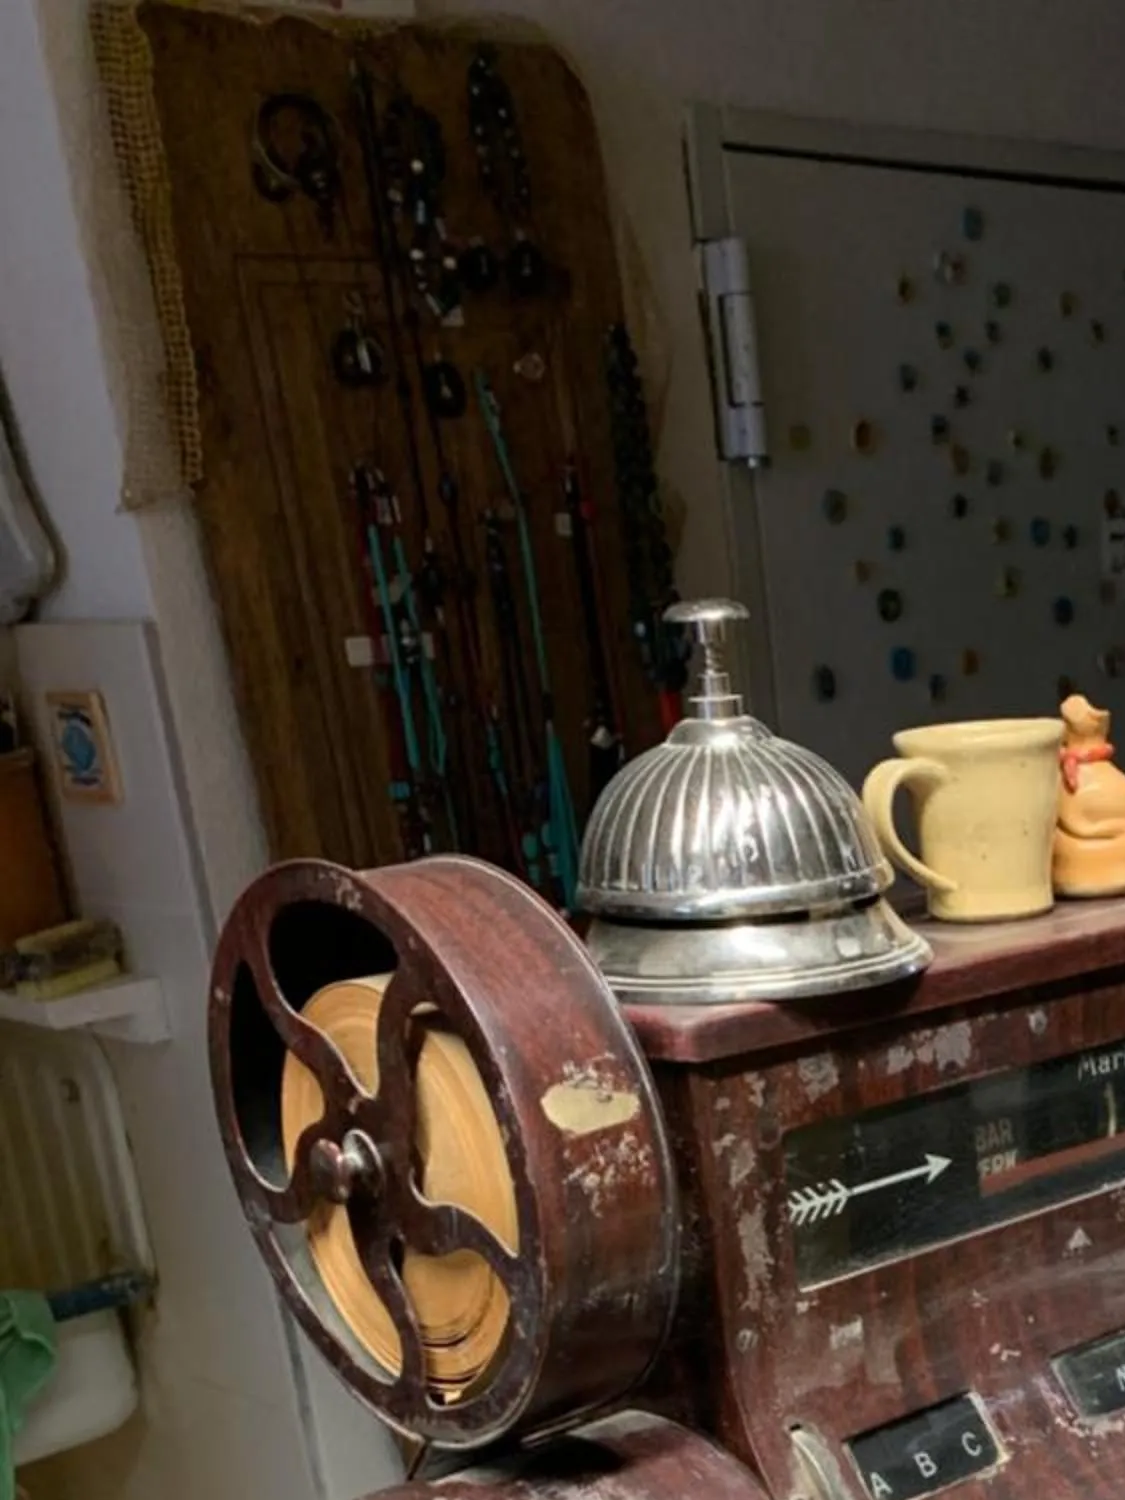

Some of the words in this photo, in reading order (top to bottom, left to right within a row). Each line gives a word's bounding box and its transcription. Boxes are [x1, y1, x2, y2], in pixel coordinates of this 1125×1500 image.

[870, 1471, 894, 1500] A
[913, 1451, 937, 1478] B
[961, 1431, 982, 1457] C
